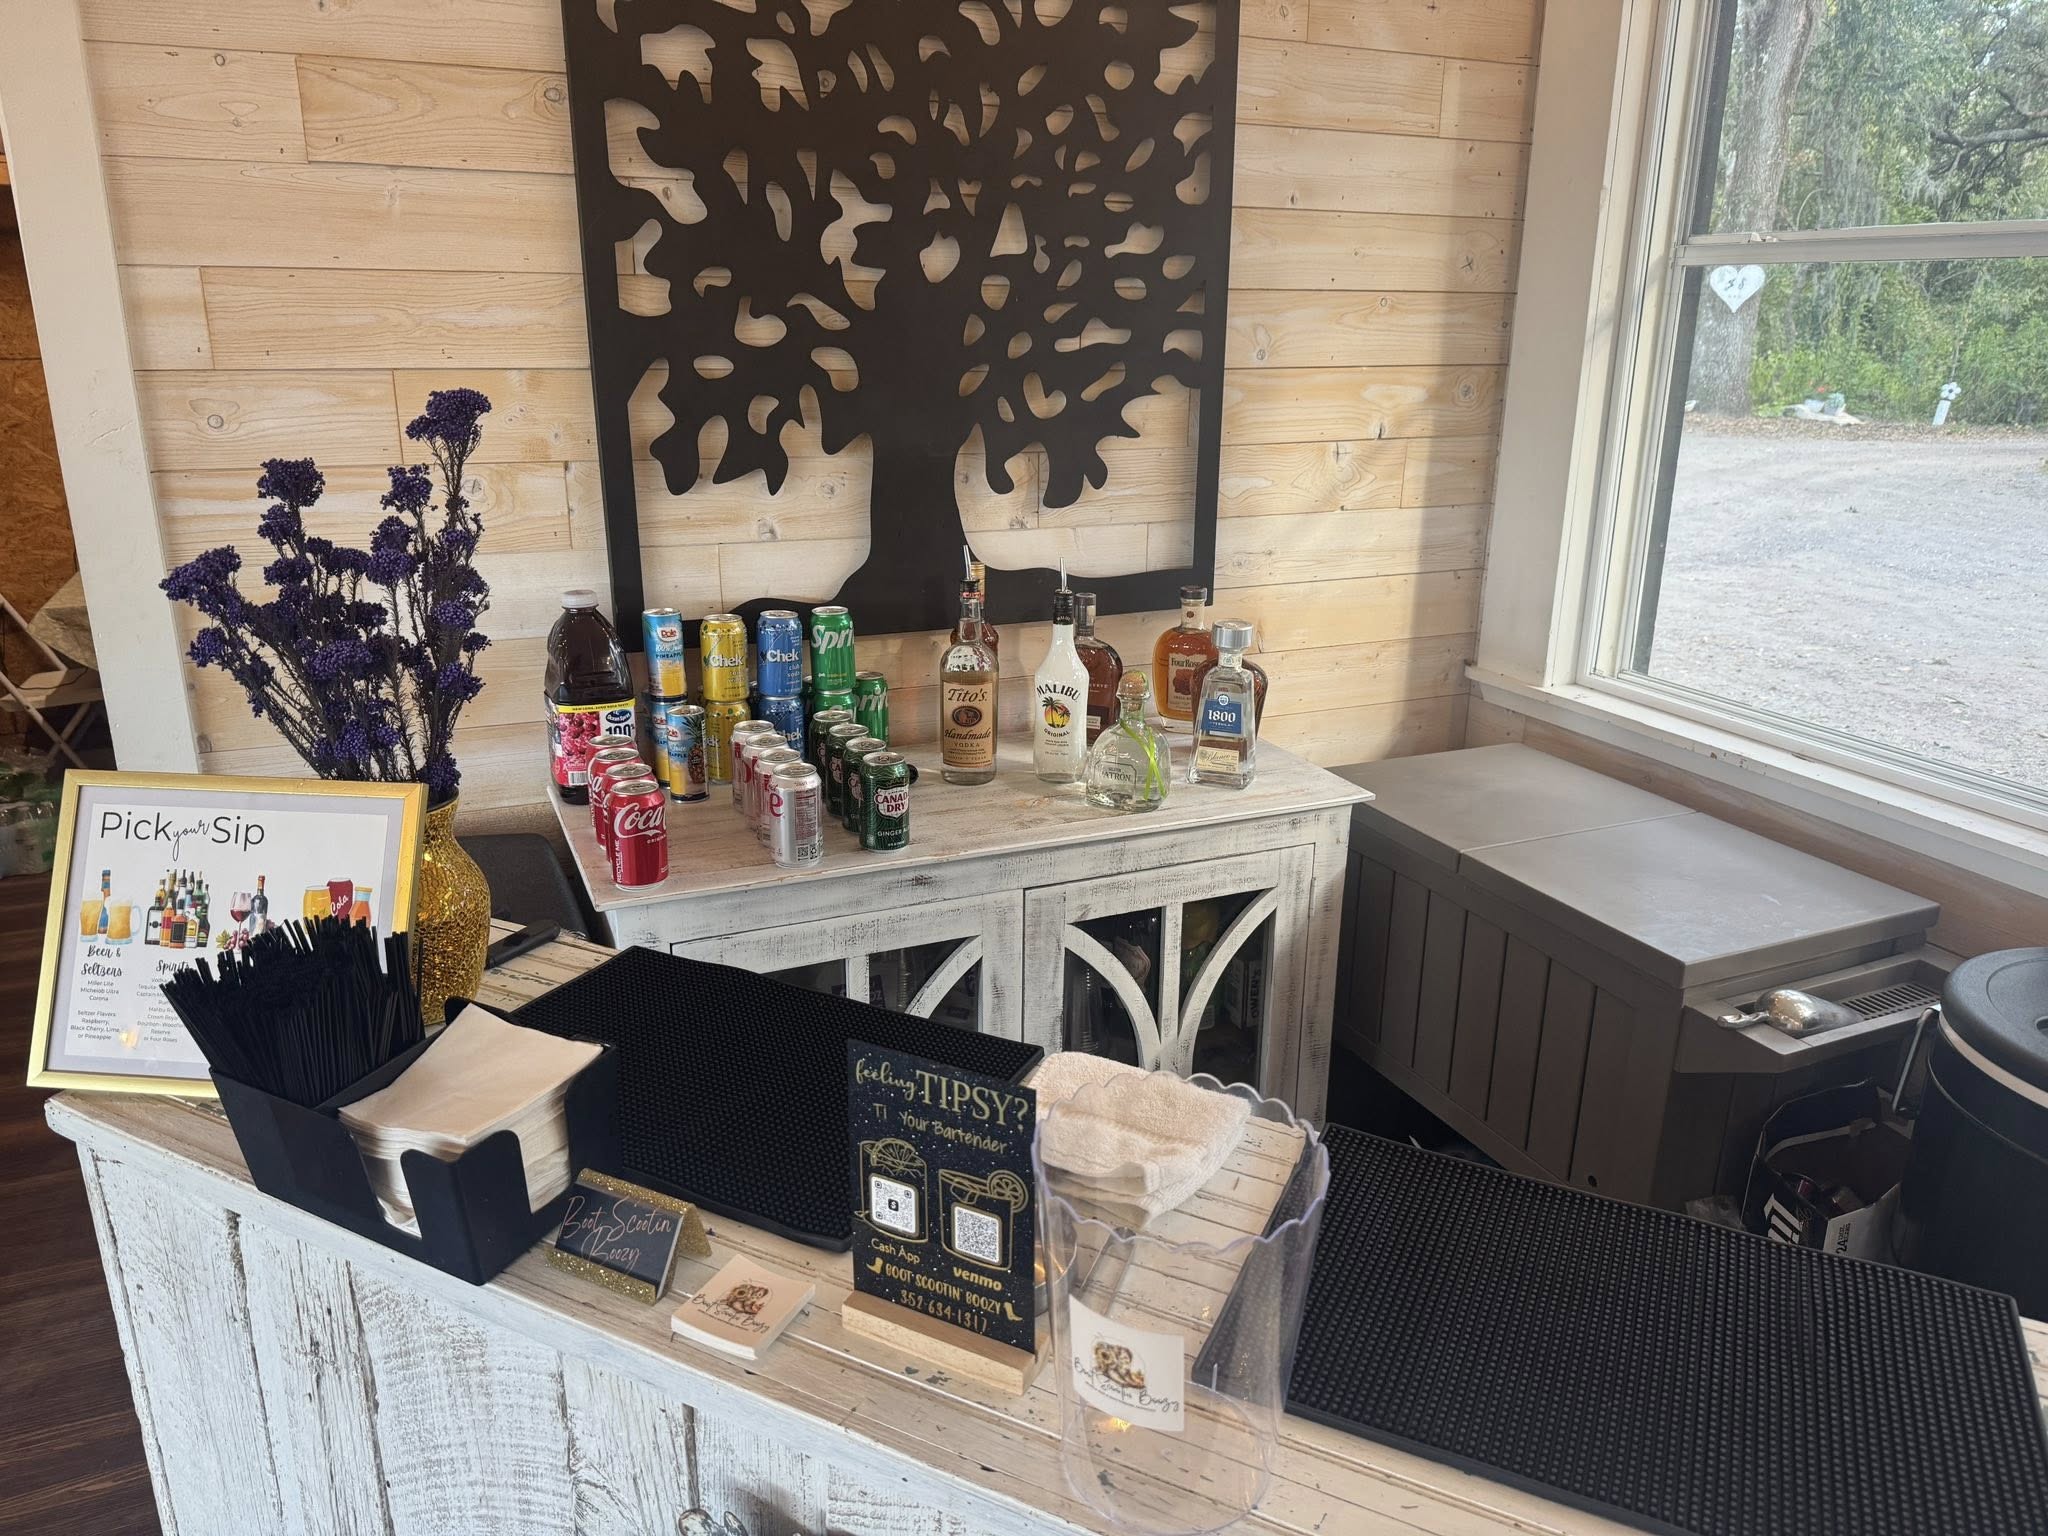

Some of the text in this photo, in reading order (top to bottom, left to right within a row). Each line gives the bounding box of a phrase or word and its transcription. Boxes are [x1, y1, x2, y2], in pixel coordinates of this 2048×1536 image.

[811, 620, 854, 654] Spri
[709, 654, 744, 668] Chek
[767, 648, 799, 662] Chek
[1171, 658, 1184, 667] Four
[1036, 683, 1081, 702] MALIBU
[1208, 710, 1236, 723] 1800
[944, 729, 991, 741] Handmade
[1044, 728, 1070, 738] ORIGINAL
[875, 792, 908, 804] CANAD
[887, 801, 906, 813] DRY
[101, 811, 265, 861] Pick your Sip
[877, 829, 902, 837] GINGER
[331, 895, 349, 916] Cola
[87, 945, 113, 958] Beer
[81, 962, 122, 977] Seltzers
[855, 1060, 1029, 1133] feeling TIPSY?
[899, 1110, 929, 1131] Your
[934, 1121, 1007, 1154] Bartender
[560, 1195, 606, 1239] Boot
[581, 1225, 641, 1275] Boozy
[871, 1238, 920, 1265] Cash App
[953, 1266, 1003, 1292] venmo
[885, 1263, 913, 1283] BOOT
[966, 1291, 1001, 1315] BOOZY
[901, 1289, 988, 1333] 352-634-1317
